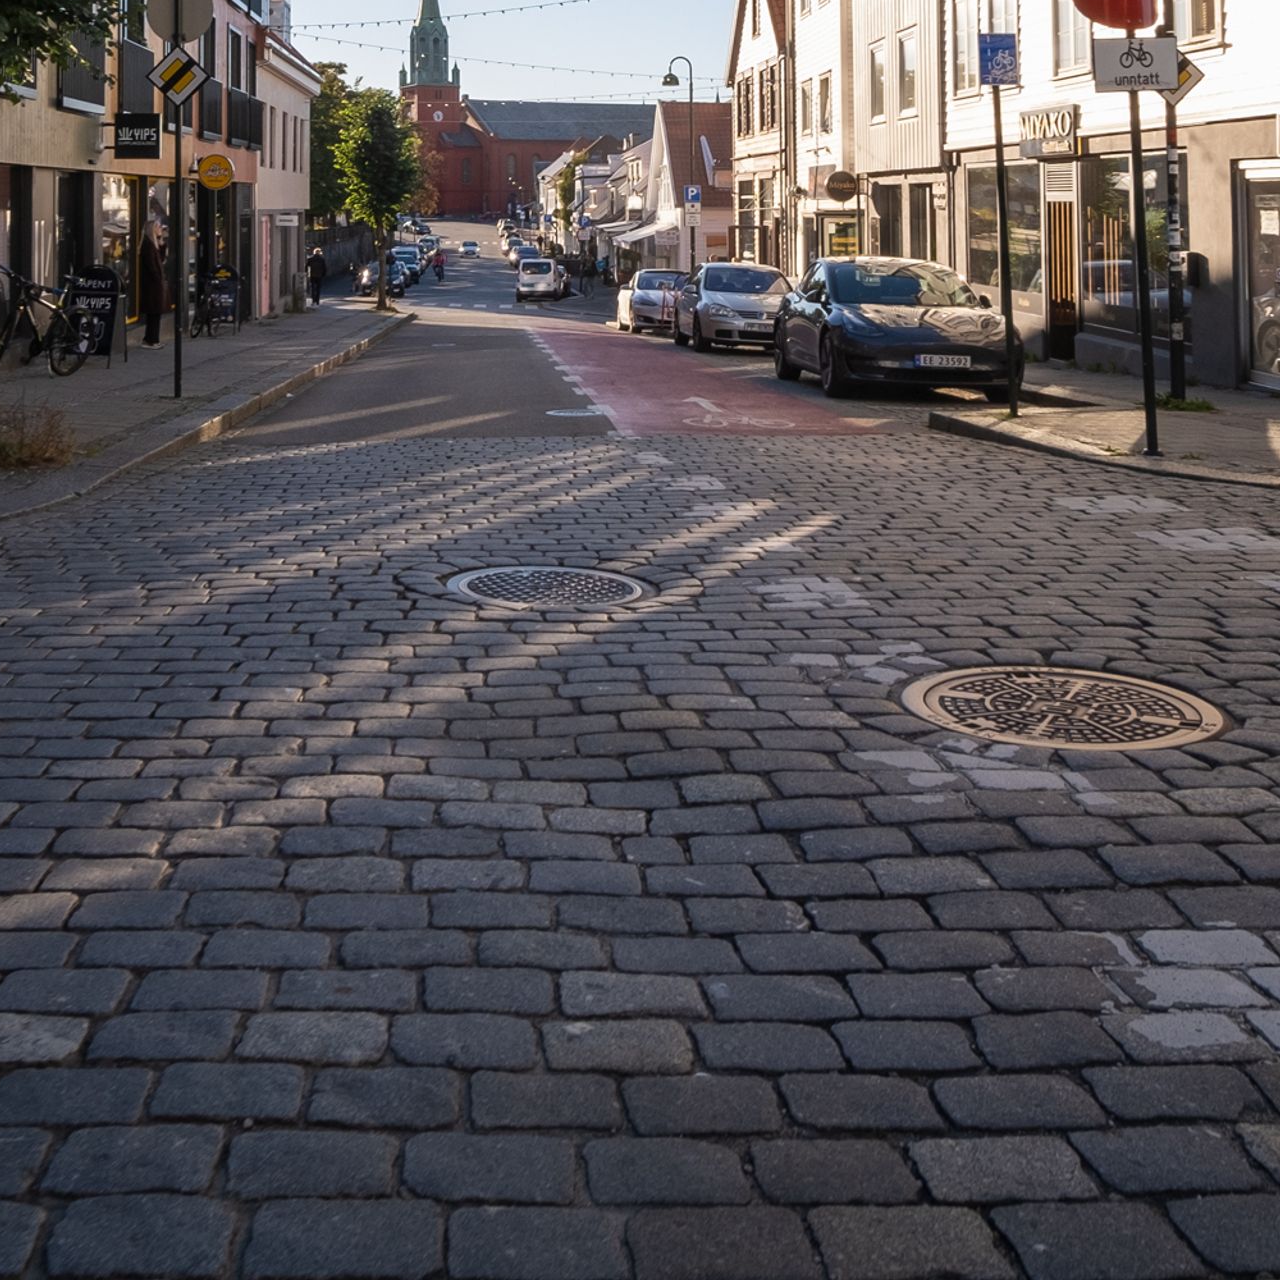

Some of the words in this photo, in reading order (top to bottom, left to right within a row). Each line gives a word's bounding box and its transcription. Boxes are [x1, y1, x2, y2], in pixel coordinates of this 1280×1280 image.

[1114, 72, 1160, 86] unntatt
[1020, 110, 1072, 140] MIYAKO
[688, 187, 697, 200] P
[923, 355, 934, 365] EE
[938, 356, 968, 366] 23592
